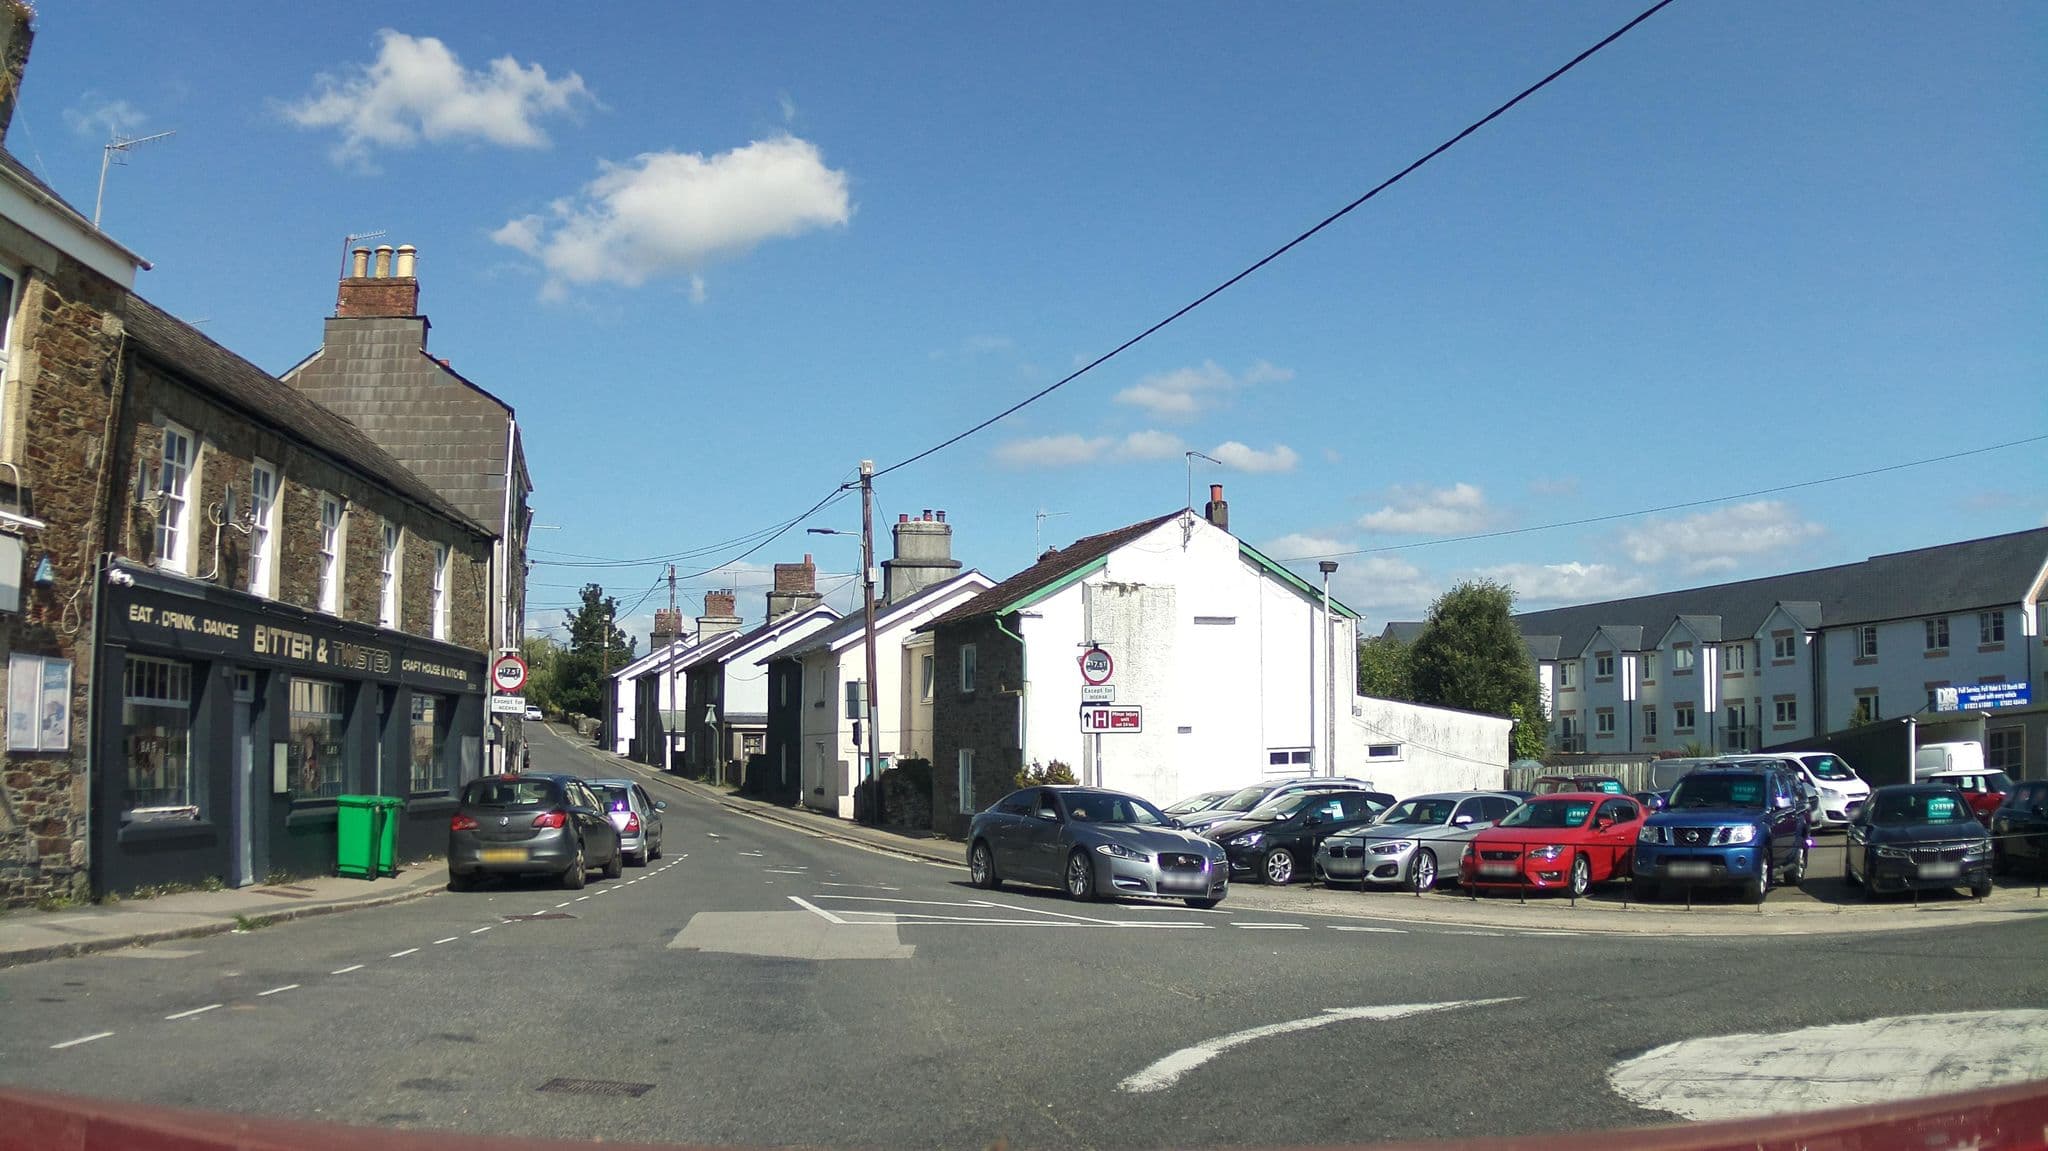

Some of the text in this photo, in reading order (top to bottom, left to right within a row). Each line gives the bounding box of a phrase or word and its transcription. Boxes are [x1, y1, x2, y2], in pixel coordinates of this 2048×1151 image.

[129, 604, 239, 639] EAT DRINK DANCE
[254, 624, 391, 673] BITTER & TWISTED
[402, 660, 421, 672] CRAFT
[422, 662, 440, 675] HOUSE
[446, 668, 467, 680] KITCHEN
[1095, 712, 1106, 727] H
